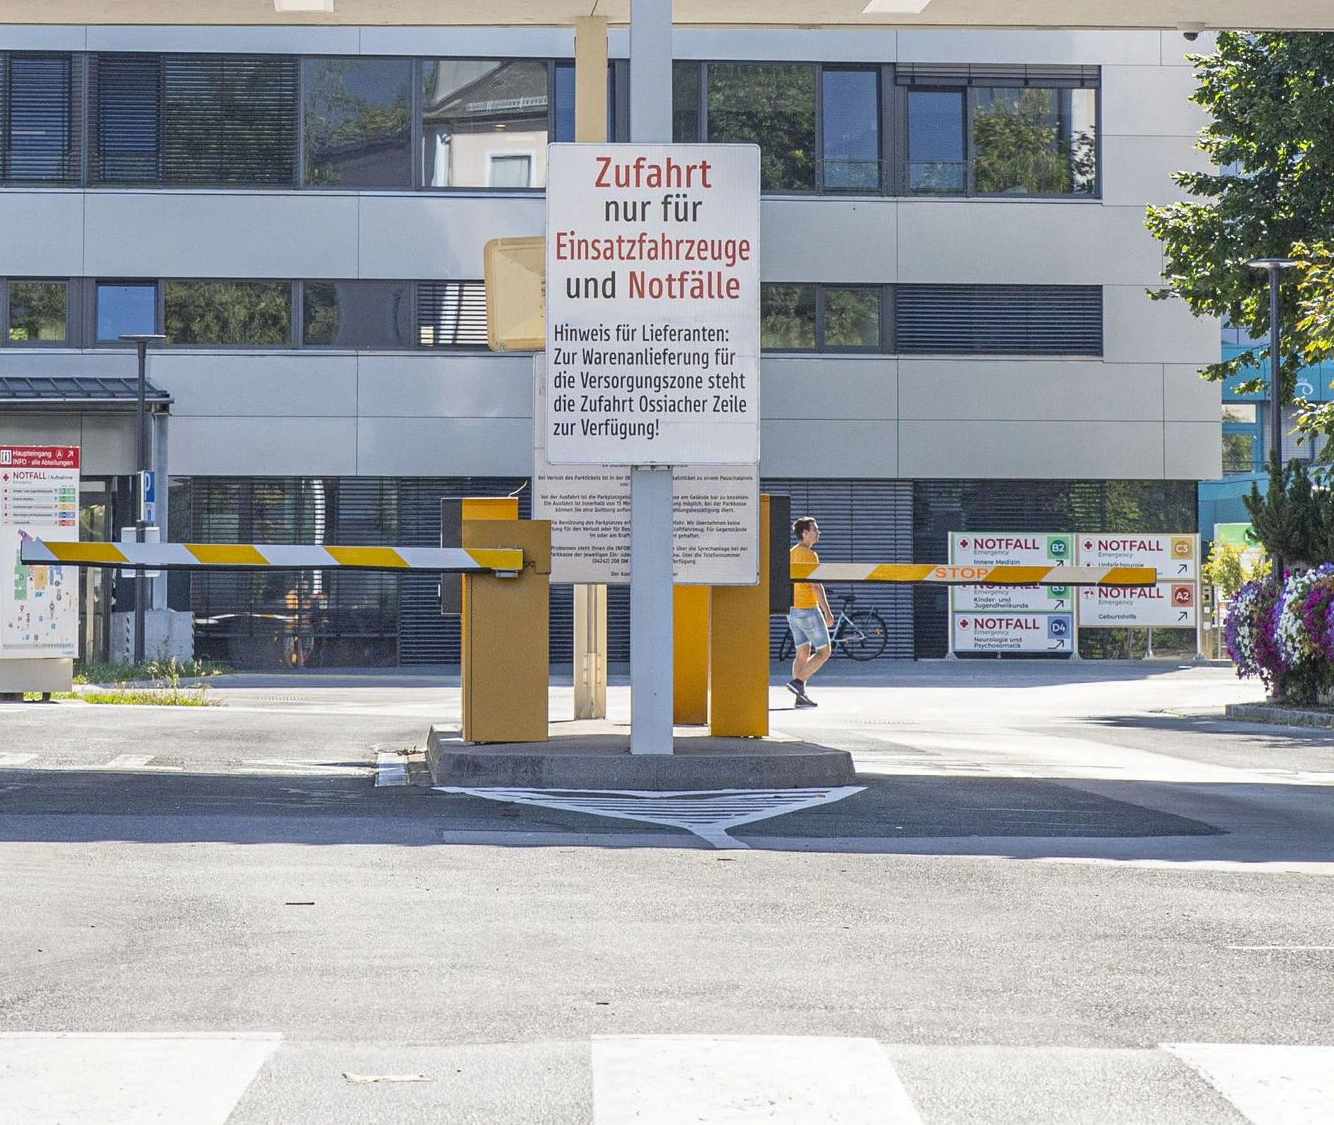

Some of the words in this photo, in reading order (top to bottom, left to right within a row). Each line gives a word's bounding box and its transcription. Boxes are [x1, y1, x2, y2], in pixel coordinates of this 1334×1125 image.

[595, 157, 712, 188] Zufahrt
[605, 200, 651, 222] nur
[661, 193, 703, 222] für
[556, 231, 750, 267] Einsatzfahrzeuge
[566, 271, 616, 299] und
[629, 270, 740, 299] Notfälle
[554, 324, 611, 342] Hinweis
[615, 323, 638, 342] für
[642, 323, 729, 342] Lieferanten:
[554, 348, 578, 365] Zur
[582, 347, 709, 369] Warenanlieferung
[714, 347, 736, 365] für
[554, 371, 576, 390] die
[580, 371, 703, 393] Versorgungszone
[708, 371, 746, 389] steht
[554, 394, 576, 413] die
[580, 394, 635, 413] Zufahrt
[639, 394, 708, 413] Ossiacher
[712, 394, 747, 413] Zeile
[553, 422, 577, 436] zur
[580, 418, 660, 440] Verfügung!
[12, 450, 52, 458] Haupteingang
[41, 459, 74, 467] Abteilungen
[12, 471, 47, 480] NOTFALL
[144, 472, 152, 501] P
[974, 538, 1040, 550] NOTFALL
[1051, 544, 1065, 552] B2
[1097, 539, 1163, 551] NOTFALL
[935, 567, 989, 579] STOP
[1098, 587, 1164, 599] NOTFALL
[1175, 592, 1189, 600] A2
[974, 618, 1040, 630] NOTFALL
[1052, 623, 1066, 632] D4
